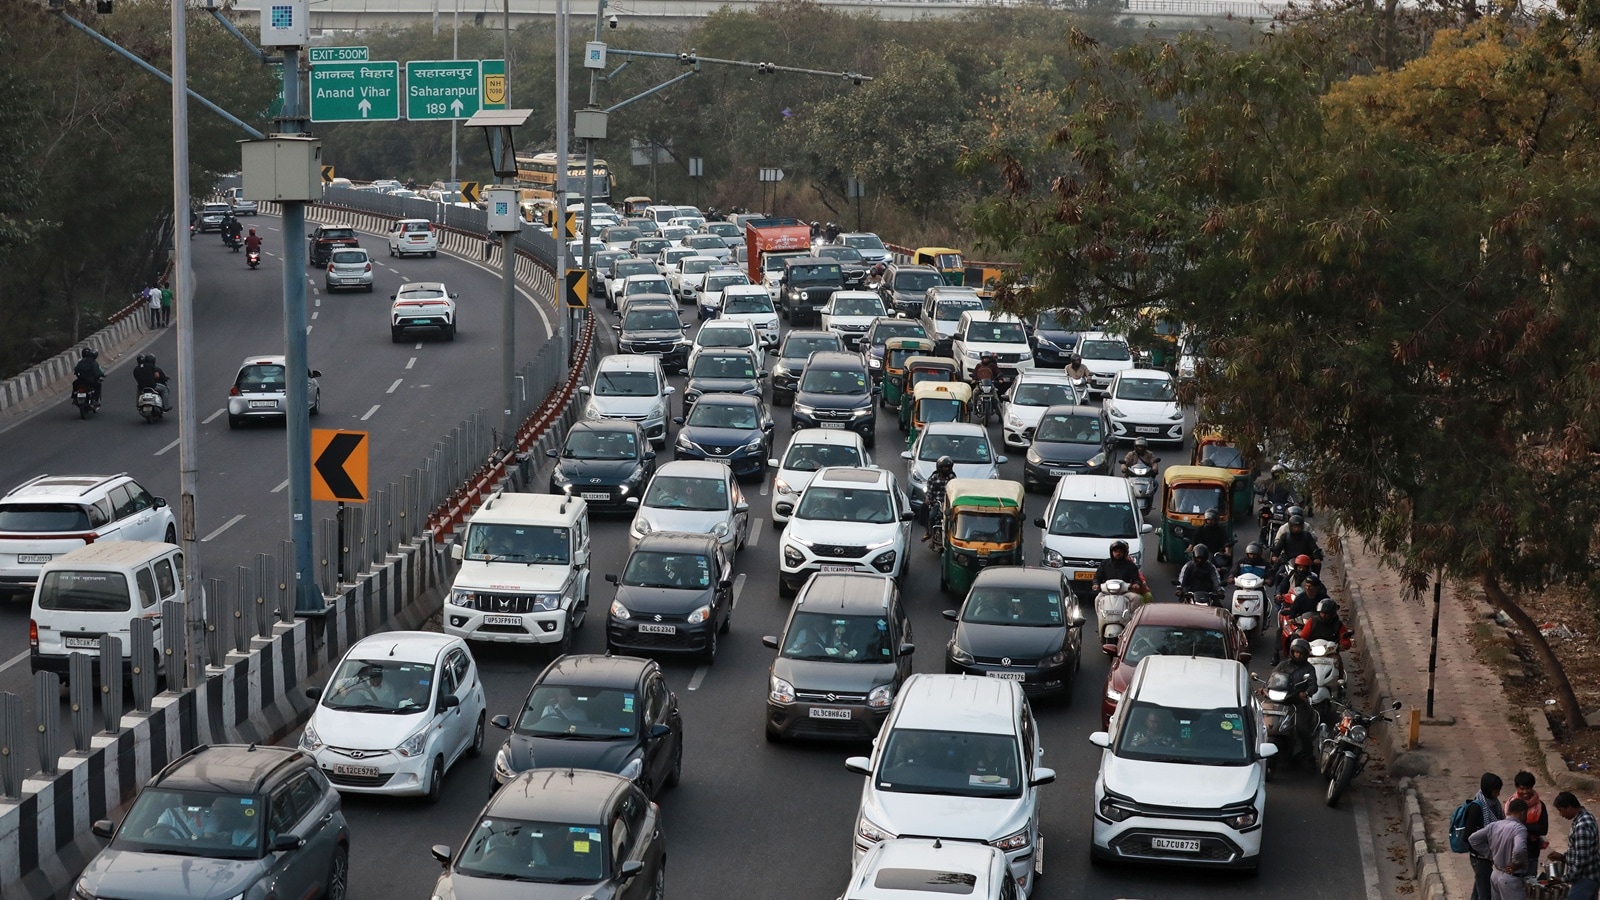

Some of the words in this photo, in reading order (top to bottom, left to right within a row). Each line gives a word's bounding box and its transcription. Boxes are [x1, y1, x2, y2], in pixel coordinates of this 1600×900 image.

[312, 50, 367, 60] EXIT-500M
[314, 70, 355, 79] आनन्द
[360, 67, 394, 78] विहार
[413, 68, 473, 79] सहारनपुर
[316, 88, 354, 98] Anand
[360, 86, 391, 97] Vihar
[410, 86, 477, 97] Saharanpur
[426, 103, 446, 114] 189
[488, 616, 521, 624] UP53FP9161
[337, 766, 377, 776] DL12CE9782
[1156, 839, 1199, 850] DL7CU8729
